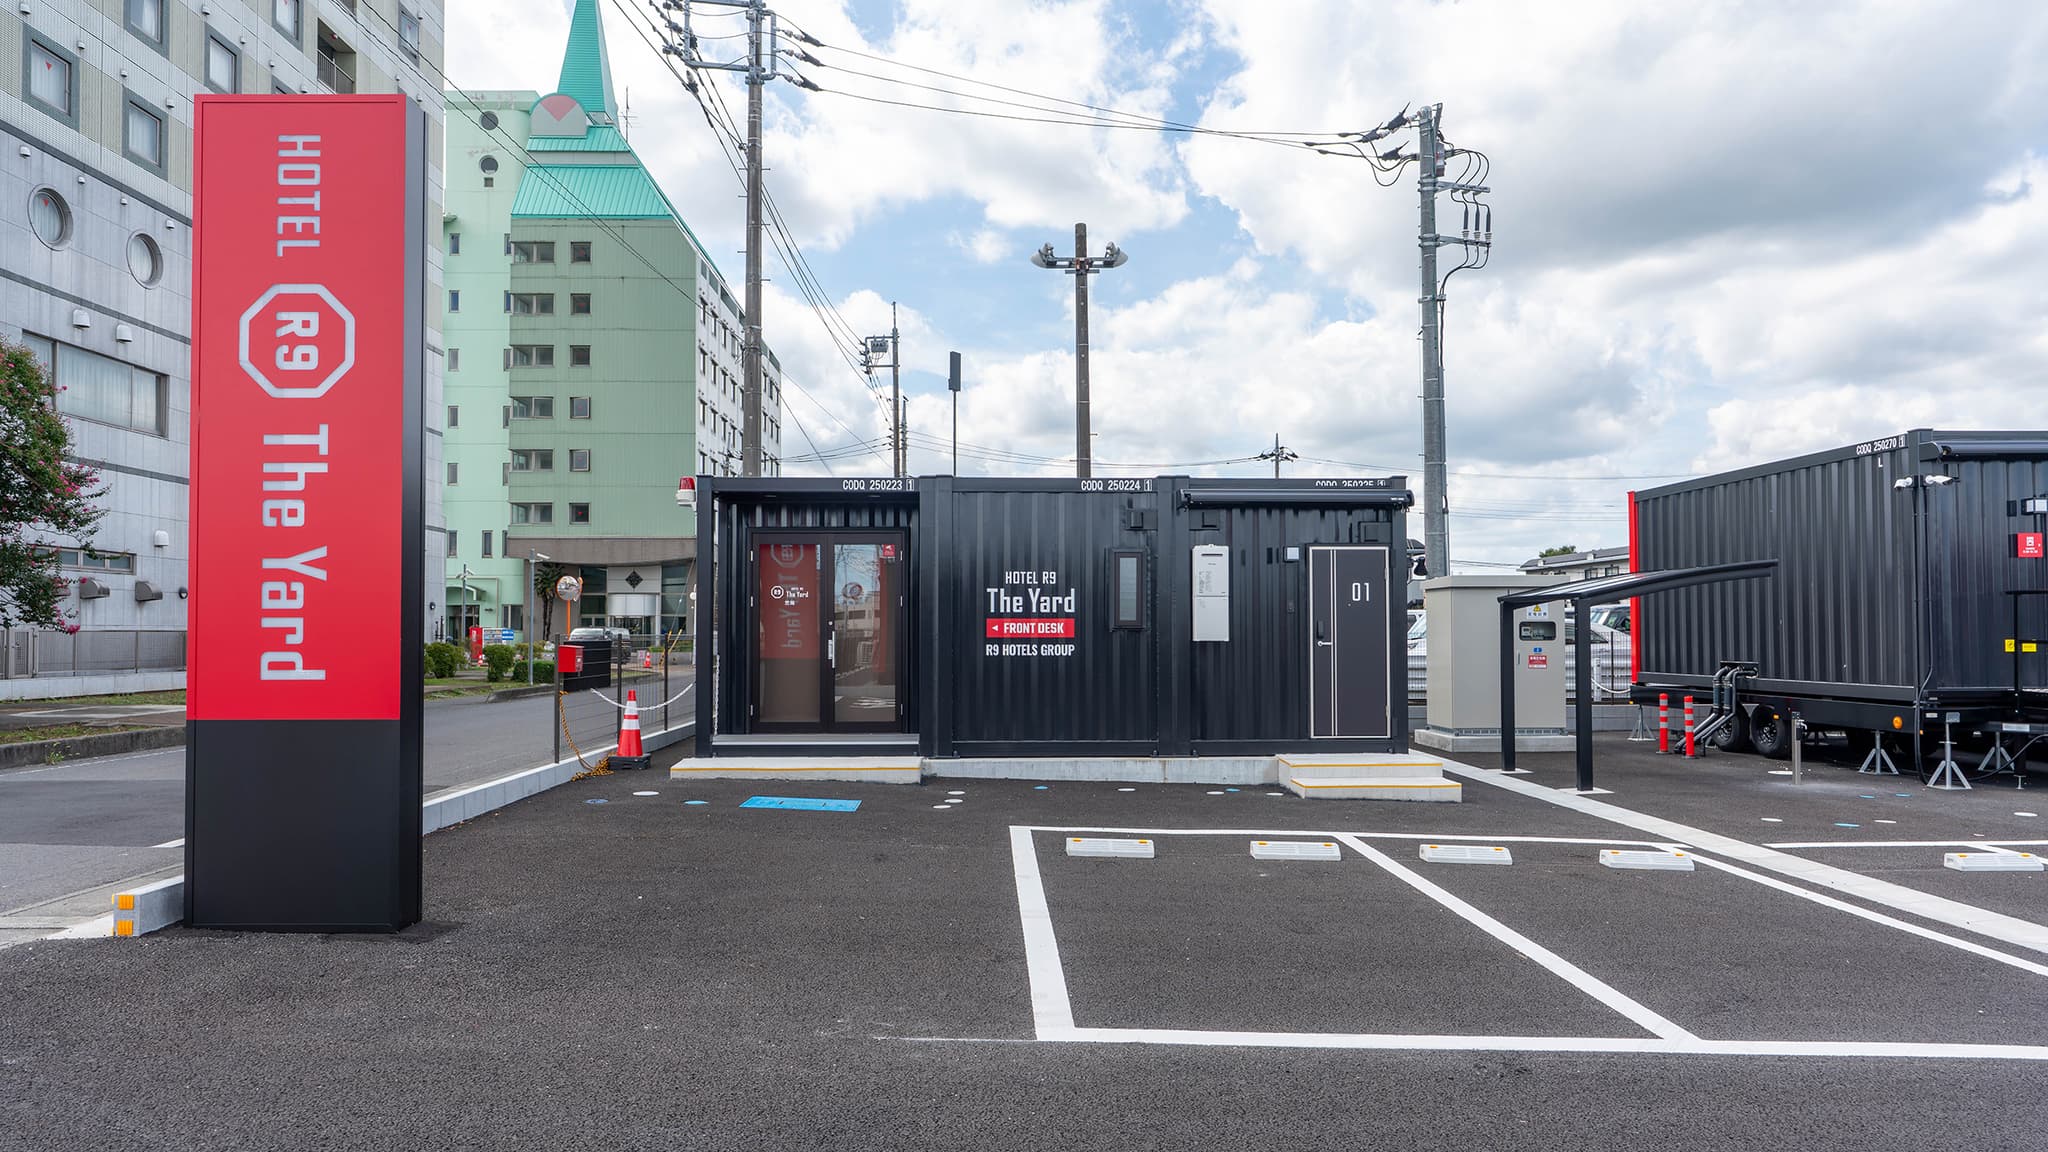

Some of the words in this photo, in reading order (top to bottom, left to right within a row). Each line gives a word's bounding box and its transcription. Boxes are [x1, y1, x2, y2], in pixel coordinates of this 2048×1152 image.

[277, 135, 321, 257] HOTEL
[275, 311, 319, 370] R9
[1856, 443, 1871, 455] CODQ
[1873, 438, 1897, 452] 250270
[1878, 457, 1883, 467] L
[263, 424, 328, 527] The
[843, 480, 865, 490] CODQ
[870, 480, 902, 490] 250223
[1081, 480, 1103, 491] CODQ
[1108, 480, 1140, 490] 250224
[1005, 571, 1038, 584] HOTEL
[1042, 571, 1056, 584] R9
[1352, 582, 1369, 601] 01
[986, 588, 1023, 613] The
[1028, 588, 1075, 613] Yard
[260, 545, 327, 680] Yard
[1003, 622, 1036, 634] FRONT
[1037, 622, 1064, 634] DESK
[986, 644, 999, 656] R9
[1002, 644, 1038, 656] HOTELS
[1040, 644, 1075, 656] GROUP
